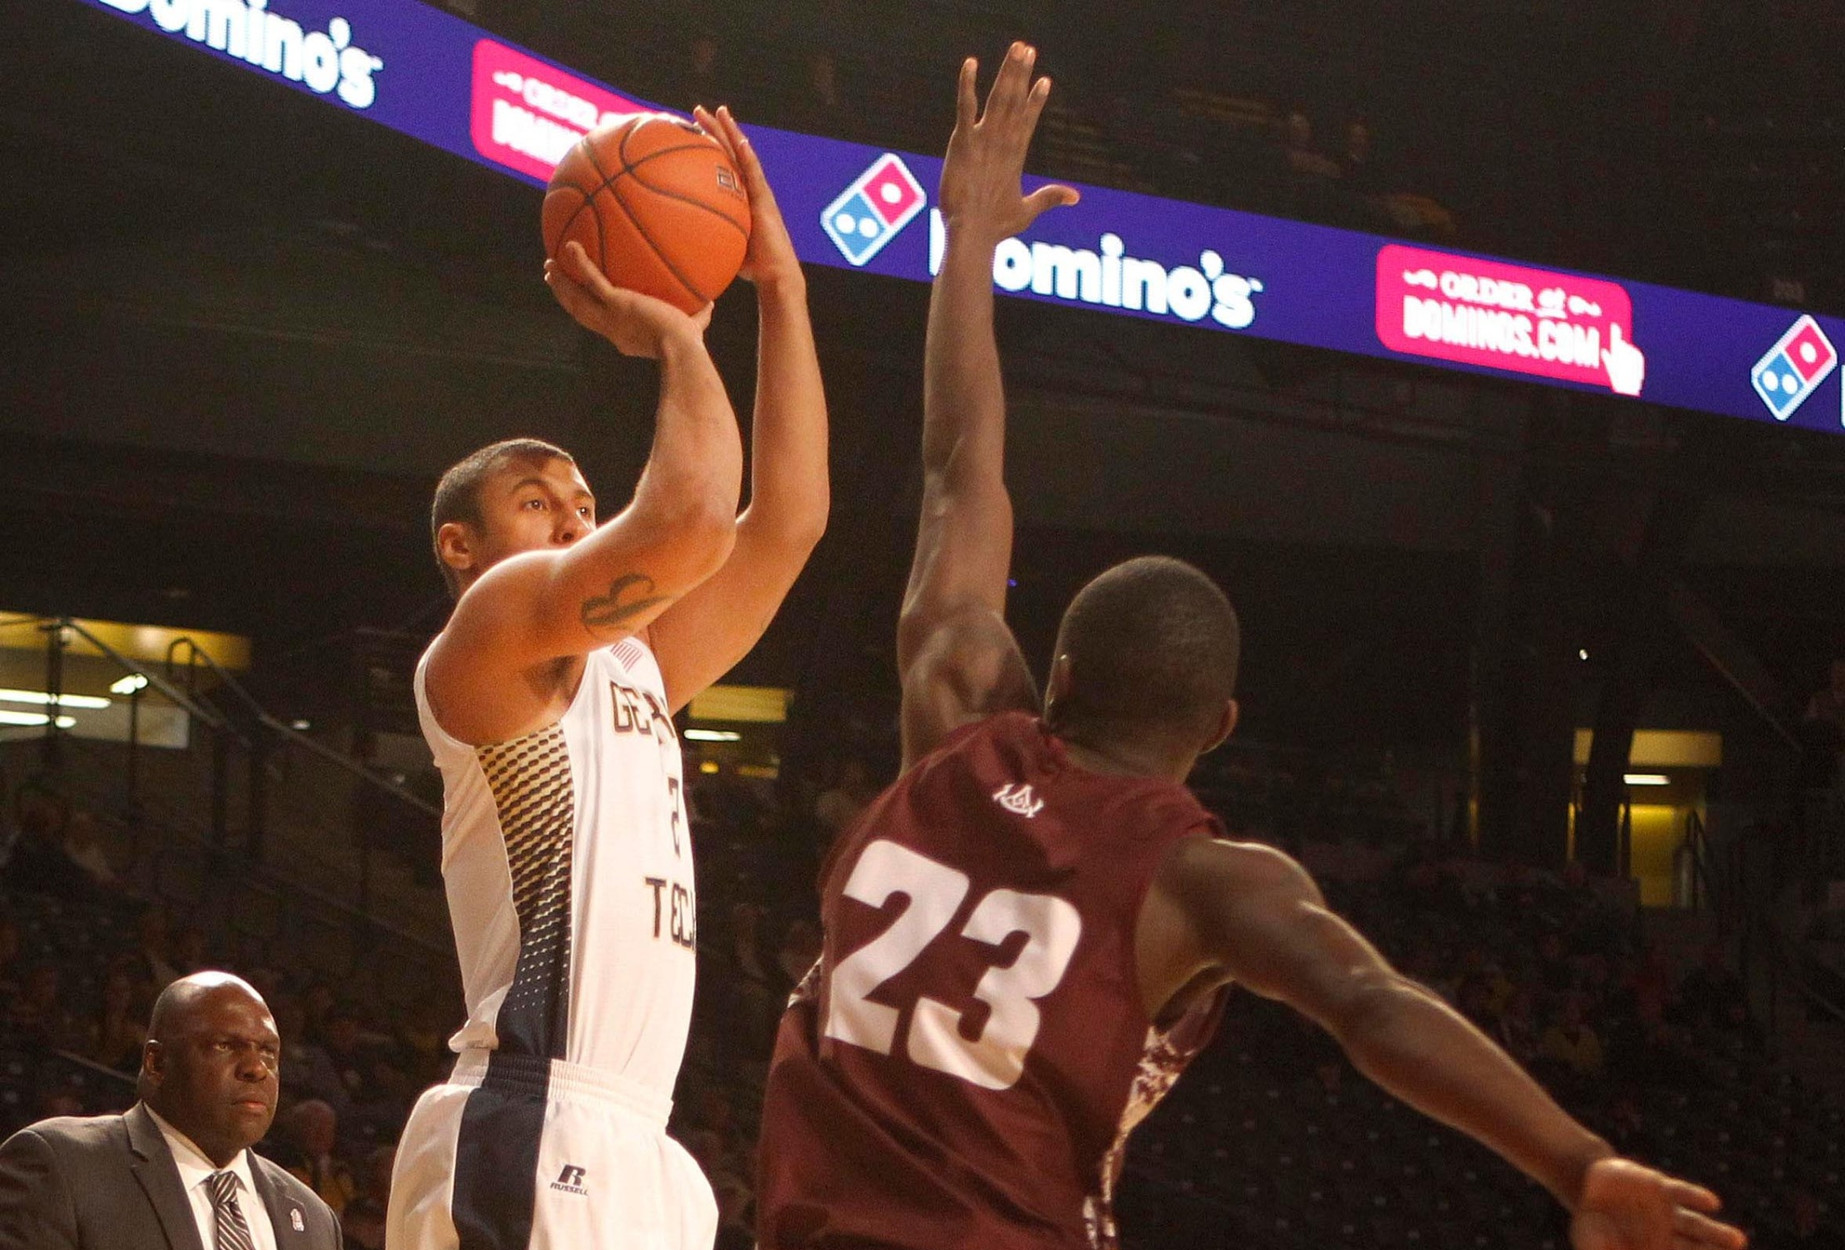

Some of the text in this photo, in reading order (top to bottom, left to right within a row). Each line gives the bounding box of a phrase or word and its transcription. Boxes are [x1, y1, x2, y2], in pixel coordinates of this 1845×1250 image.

[1440, 271, 1534, 312] ORDER
[1403, 295, 1599, 369] DOMINOS.COM
[825, 840, 1081, 1090] 23
[550, 1182, 589, 1197] RUSSELL
